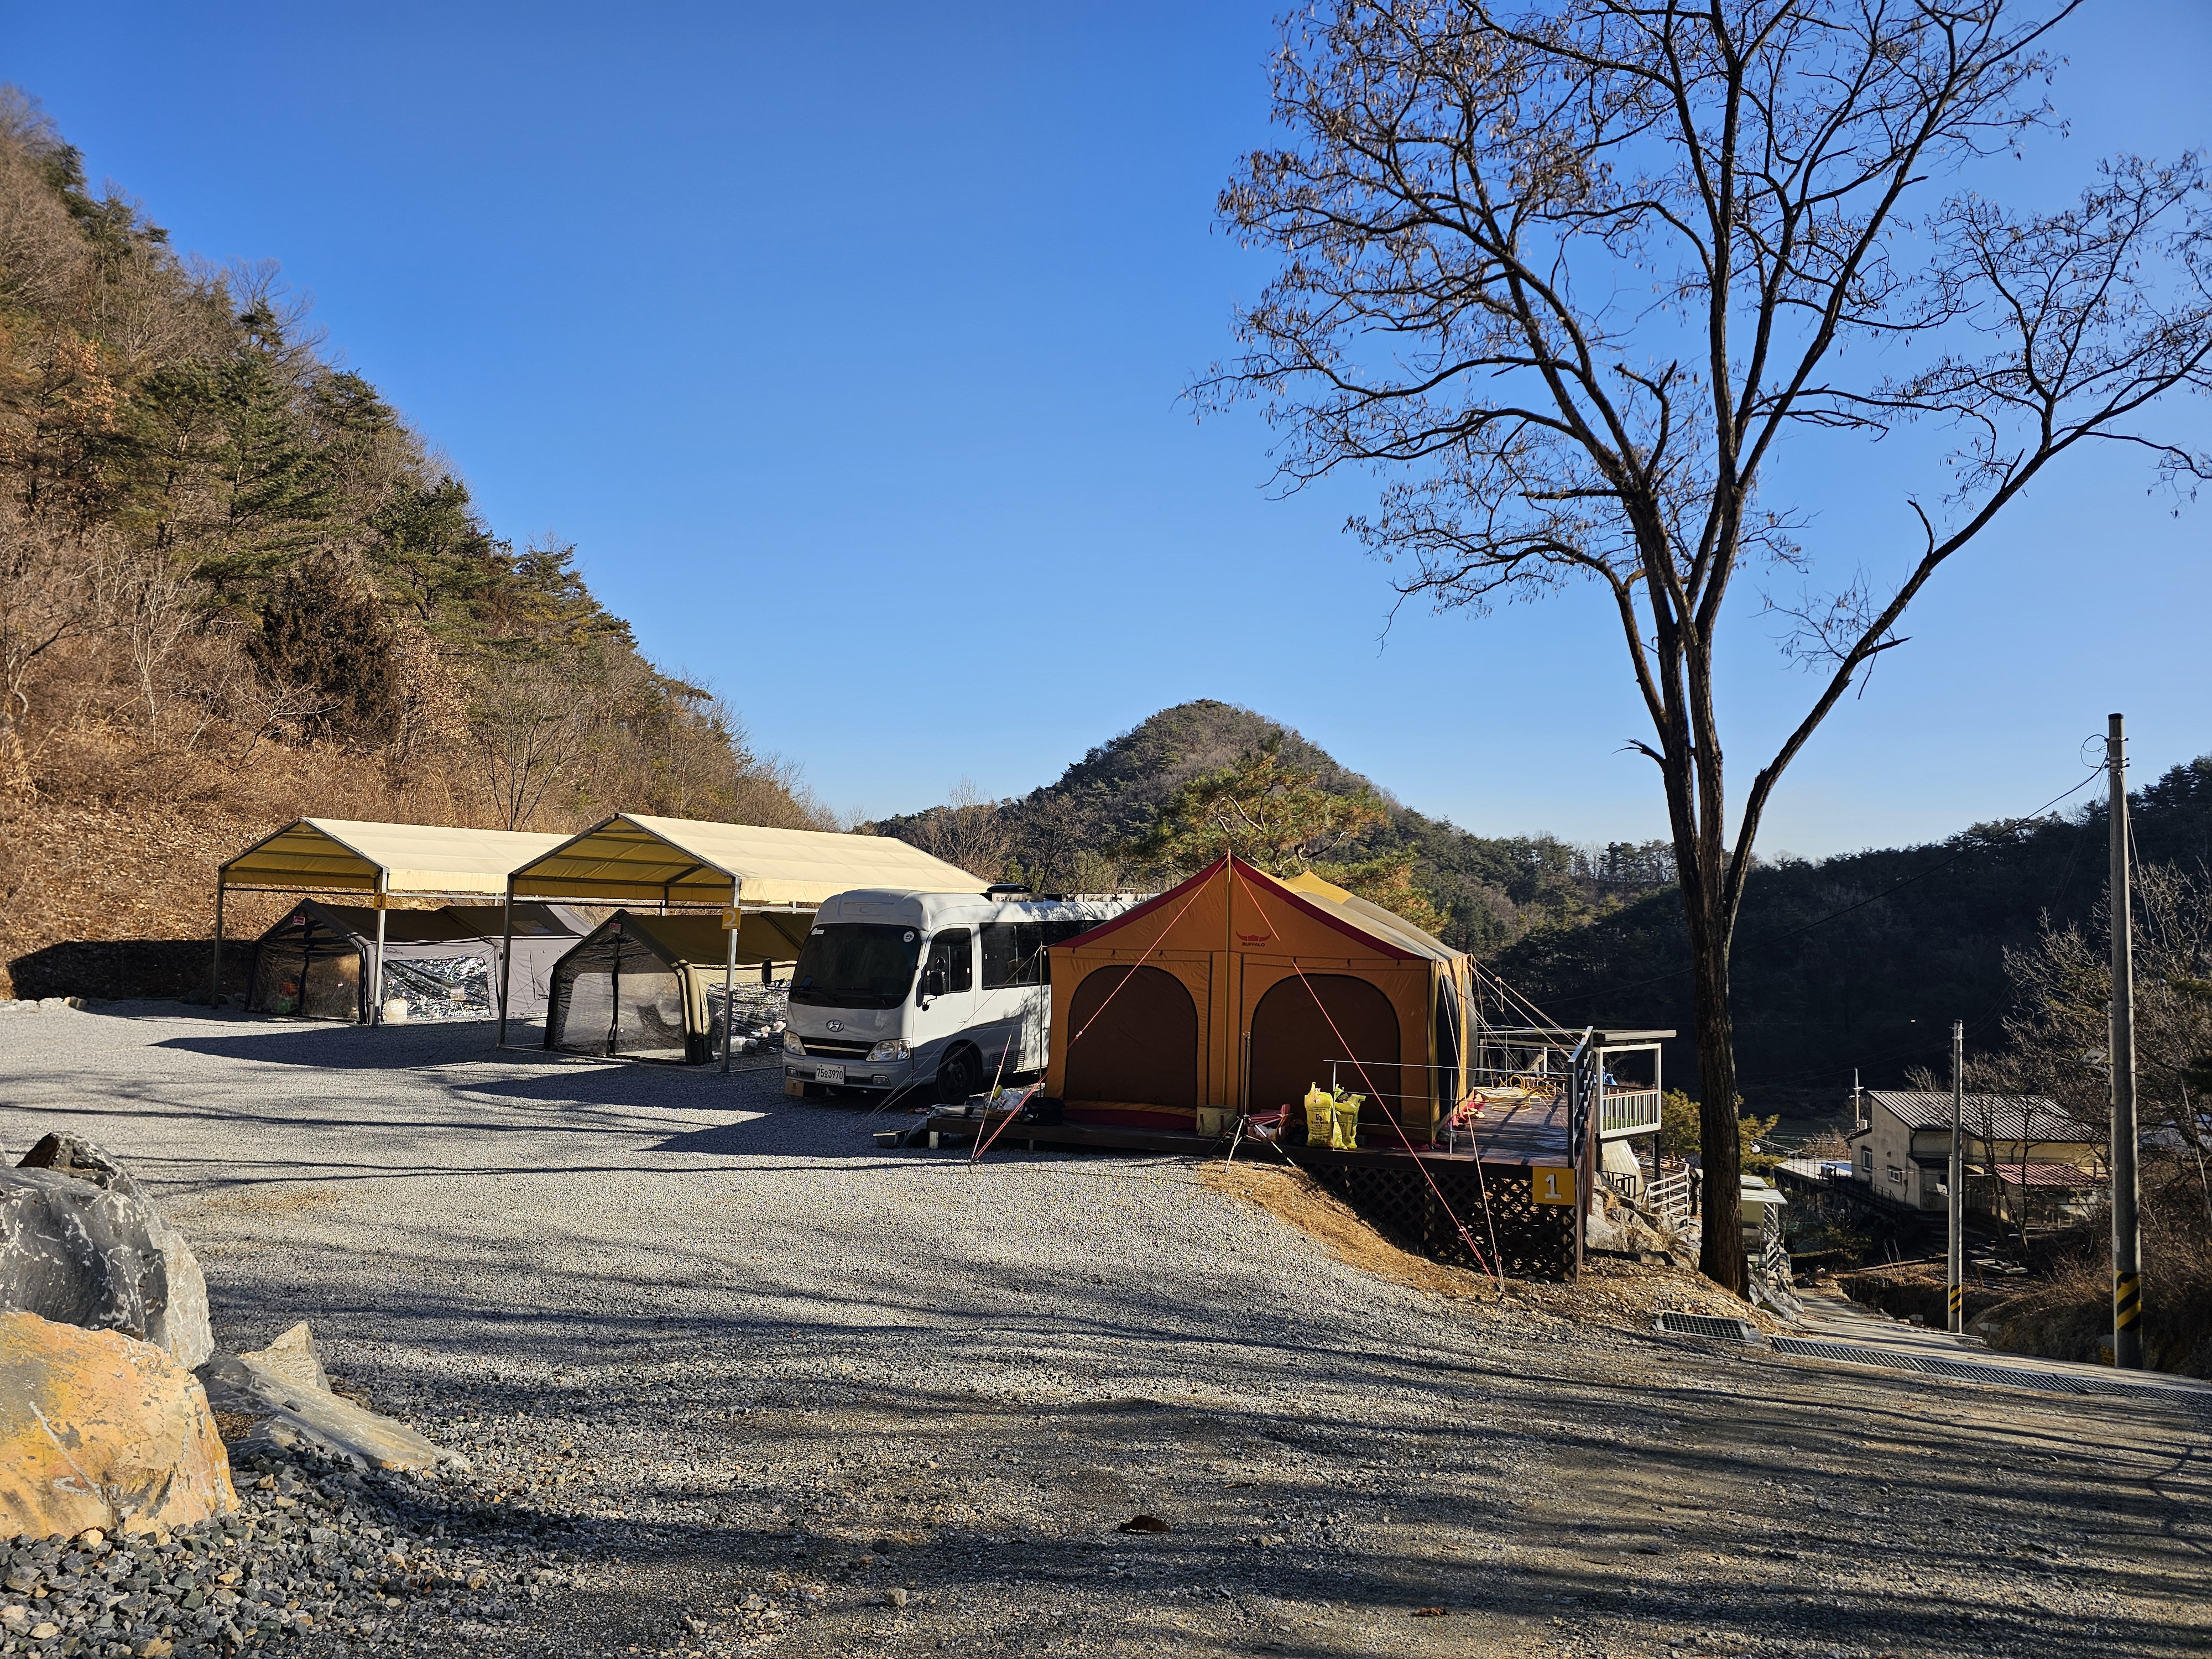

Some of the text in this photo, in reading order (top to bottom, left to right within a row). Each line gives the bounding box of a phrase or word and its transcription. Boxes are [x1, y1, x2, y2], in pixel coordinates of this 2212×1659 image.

[377, 894, 383, 907] 3
[724, 910, 737, 927] 2
[817, 1068, 843, 1080] 75오3970
[1545, 1174, 1562, 1199] 1
